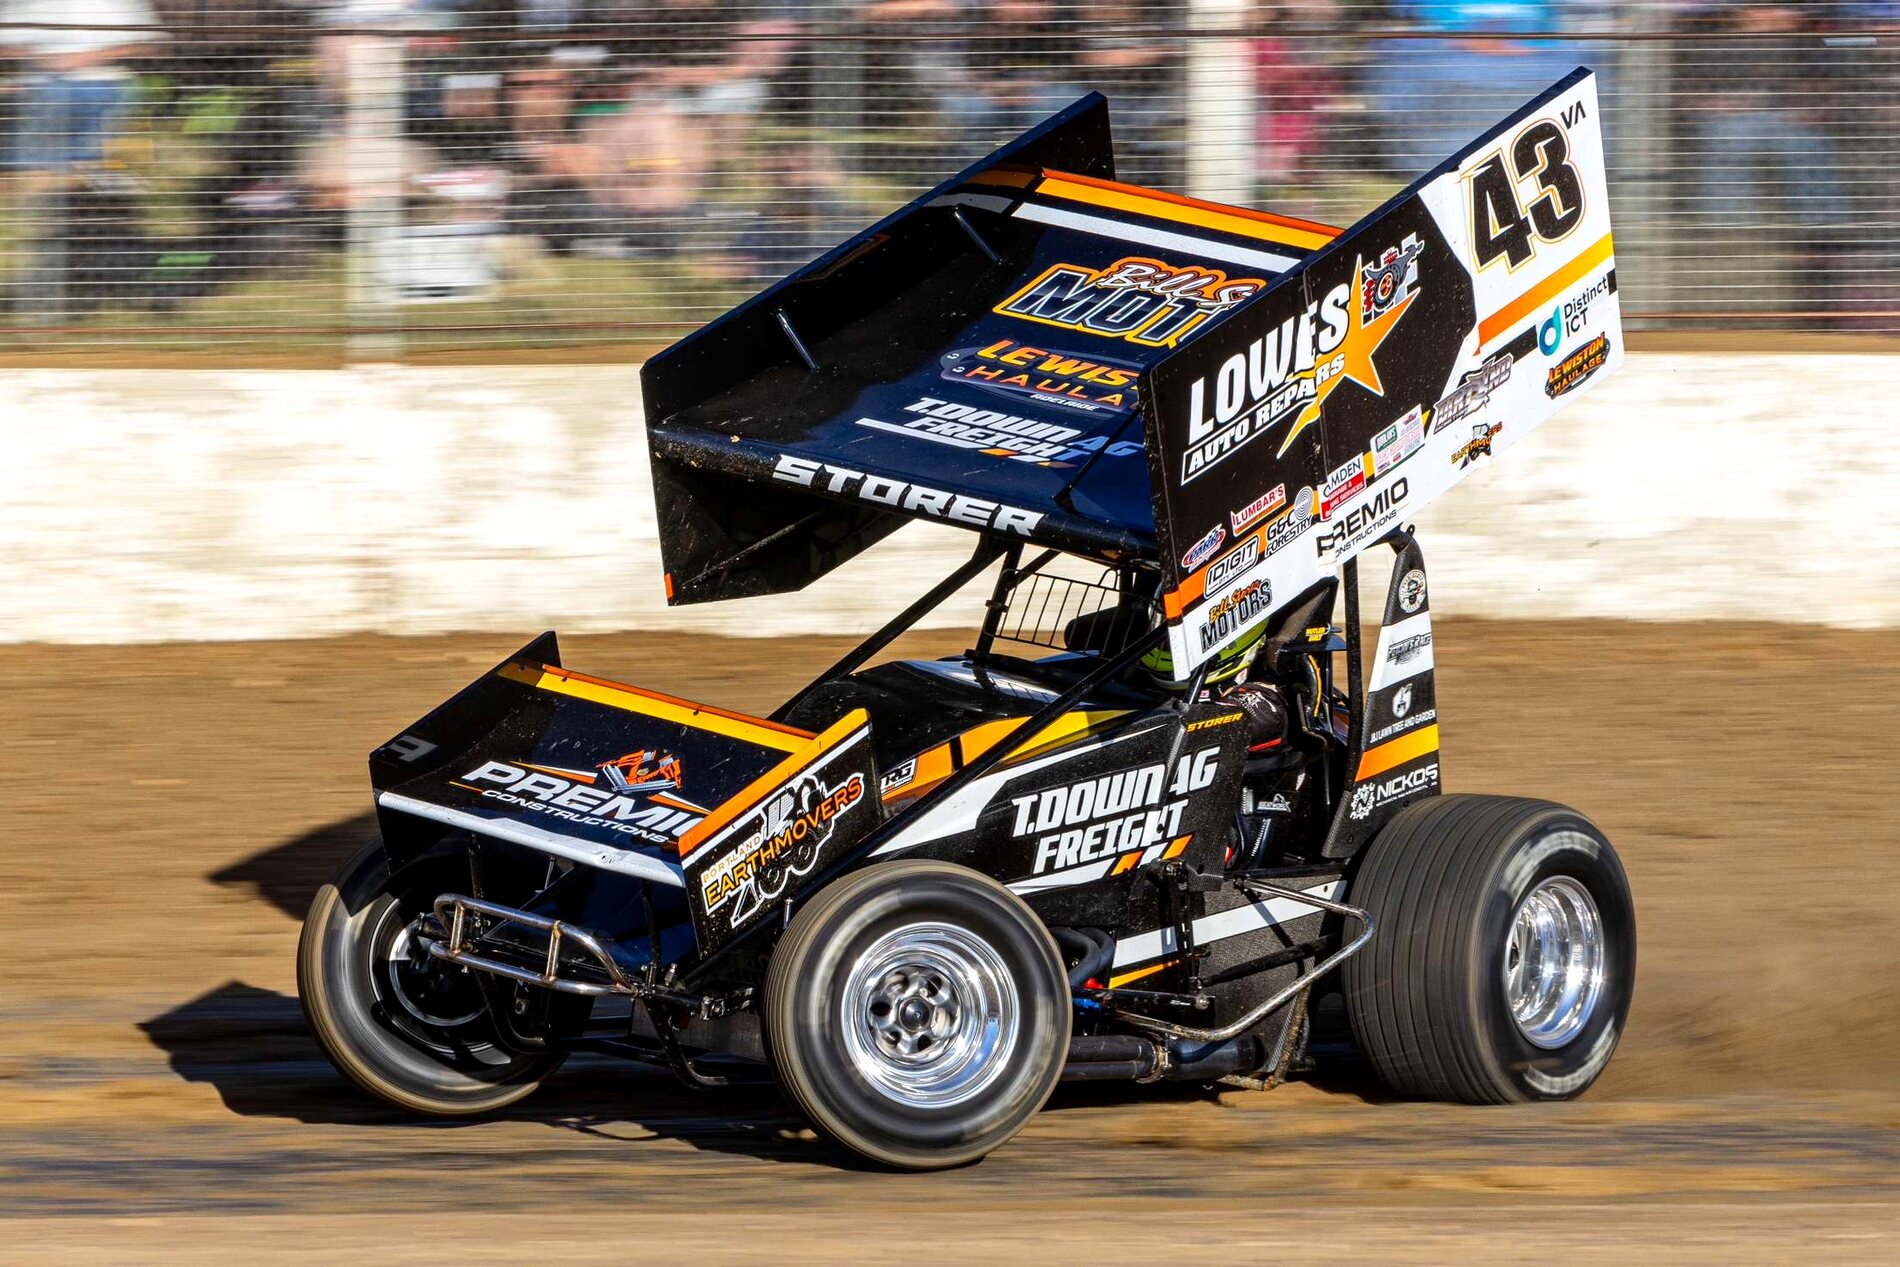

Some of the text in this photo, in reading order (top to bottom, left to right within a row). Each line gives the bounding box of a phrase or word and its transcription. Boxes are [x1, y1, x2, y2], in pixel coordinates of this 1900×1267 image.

[1471, 119, 1585, 273] 43
[1006, 269, 1231, 342] MOT
[1564, 276, 1608, 319] Distinct
[1565, 306, 1588, 338] ICT
[977, 339, 1139, 388] LEWIS
[1188, 283, 1350, 446] LOWES
[1549, 331, 1605, 383] LEWISTON
[1553, 353, 1603, 394] HAULAGE
[965, 366, 1138, 408] HAULA
[1188, 352, 1346, 474] AUTO REPARS
[903, 397, 1145, 457] T.DOWN AG
[904, 416, 1091, 461] FREIGHT
[772, 454, 1046, 537] STORER
[1316, 477, 1408, 558] PREMIO
[1266, 516, 1312, 556] FORESTRY
[1336, 509, 1397, 557] ONSTRUCTIONS
[1199, 578, 1273, 654] MOTORS
[1186, 712, 1244, 733] STORER
[1415, 708, 1436, 723] GARDEN
[1011, 746, 1220, 838] T.DOWN AG
[1376, 763, 1438, 801] NICKOS
[482, 789, 669, 844] CONSTRUCTIONS
[705, 776, 863, 906] EARTHMOVERS
[1033, 799, 1189, 875] FREIGHT
[703, 835, 761, 884] PORTLAND
